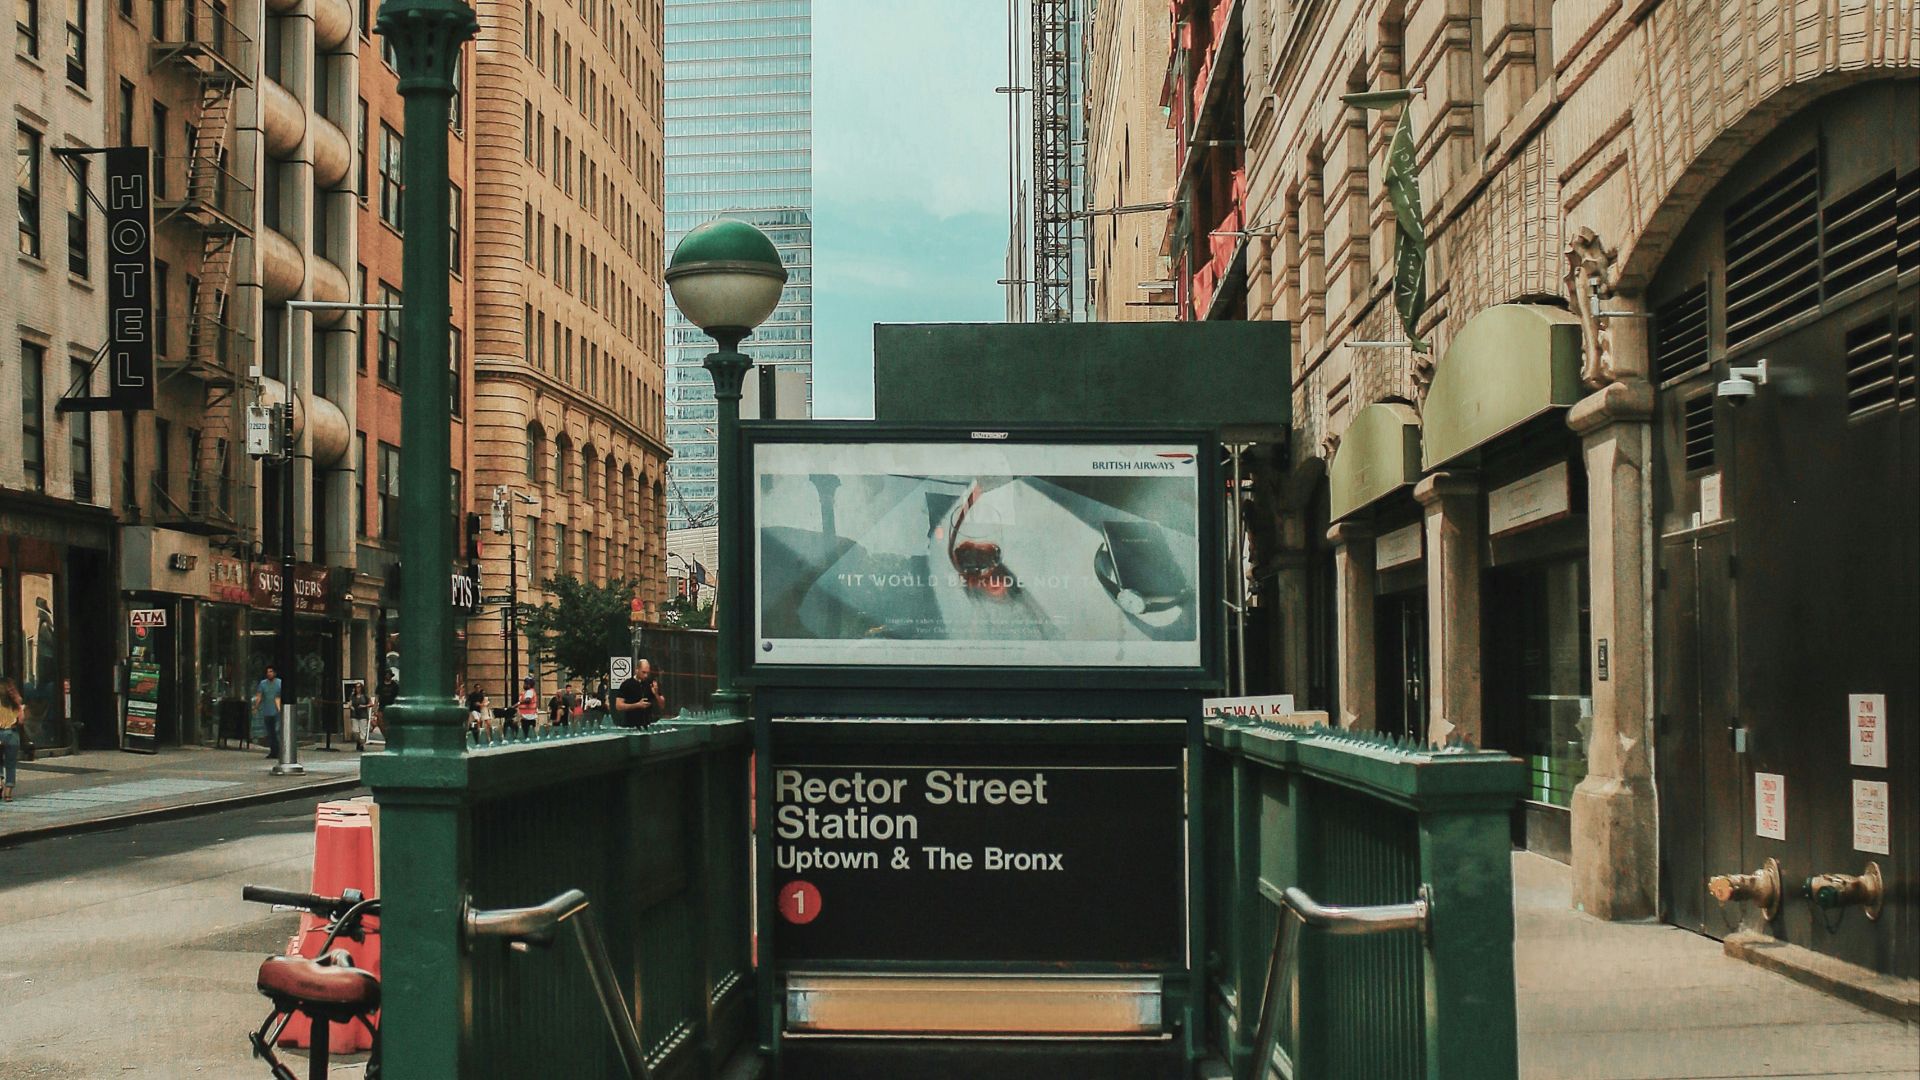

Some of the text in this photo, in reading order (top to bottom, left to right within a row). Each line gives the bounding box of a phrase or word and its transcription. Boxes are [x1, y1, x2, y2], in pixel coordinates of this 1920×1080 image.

[112, 175, 146, 387] HOTEL
[1092, 461, 1175, 470] BRITISH AIRWAYS
[259, 572, 322, 598] SUSNDERS
[871, 574, 938, 587] WOULD
[948, 575, 967, 588] BE
[978, 575, 1024, 588] RUDE
[132, 611, 164, 622] ATM
[776, 770, 1048, 804] Rector Street
[777, 805, 918, 839] Station
[777, 846, 1064, 873] Uptown & The Bronx
[792, 890, 804, 914] 1
